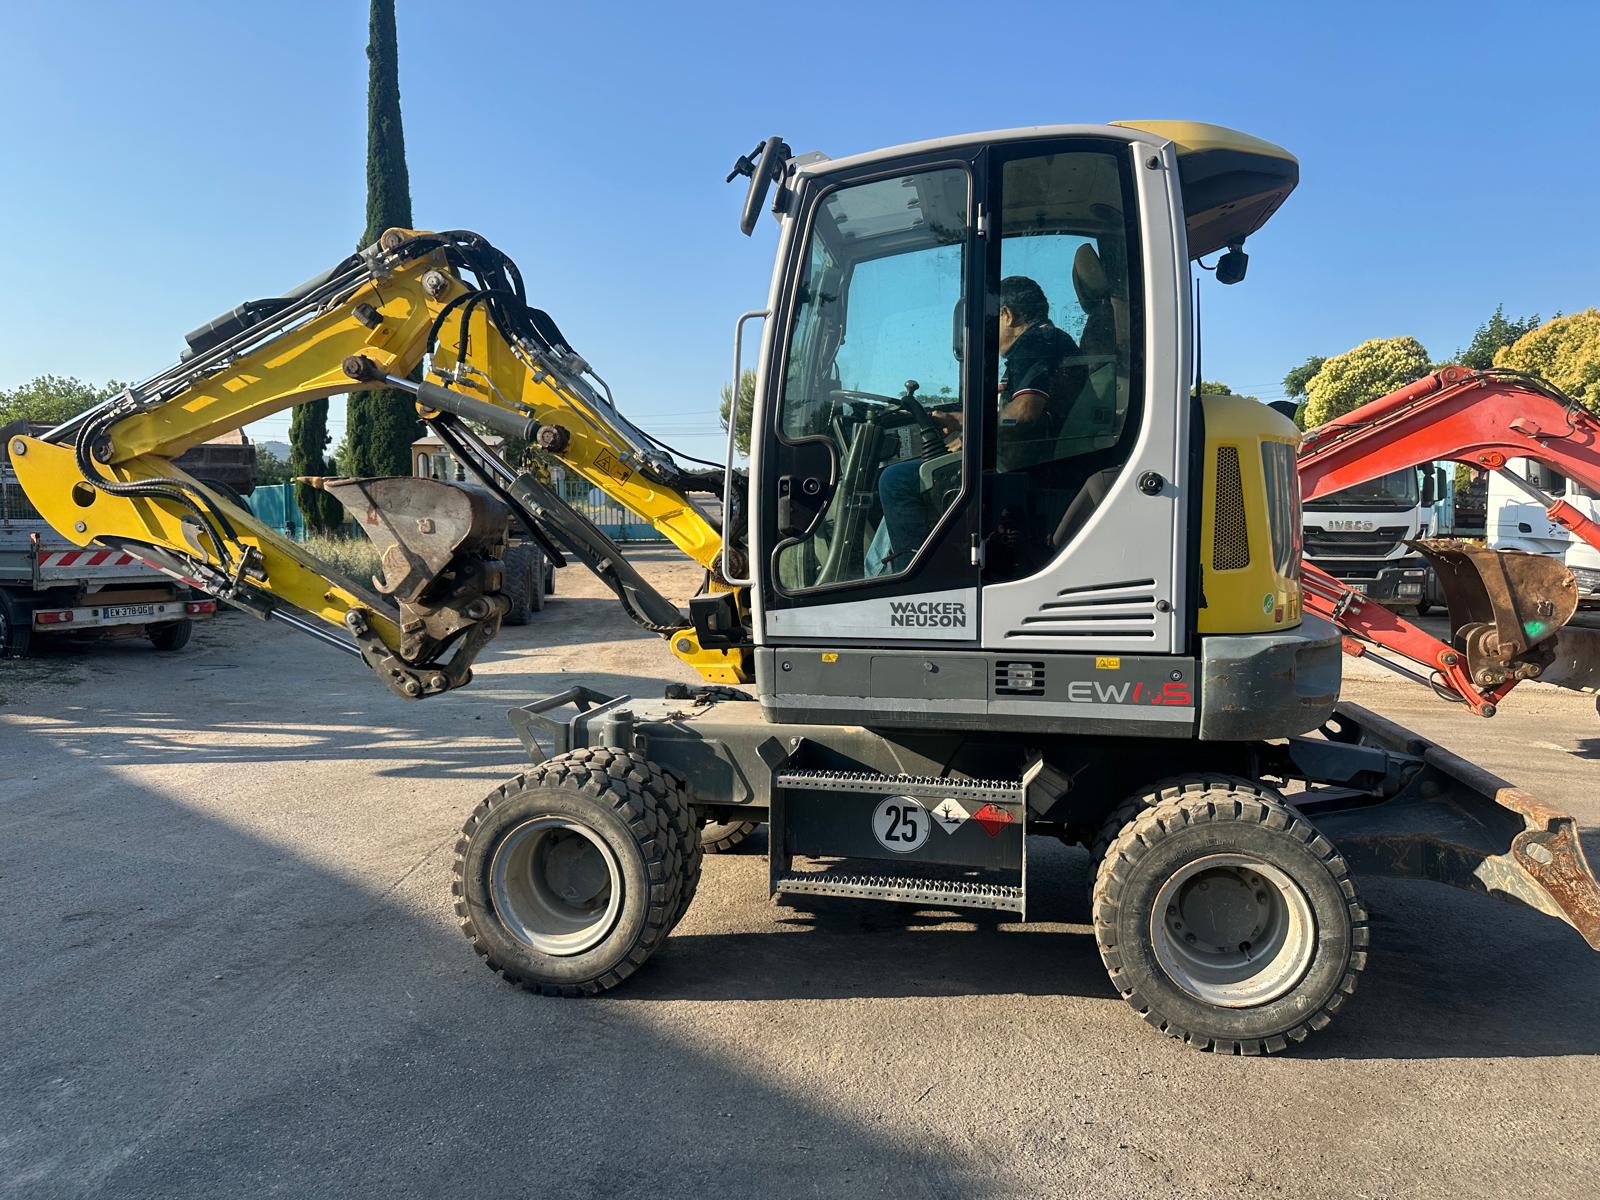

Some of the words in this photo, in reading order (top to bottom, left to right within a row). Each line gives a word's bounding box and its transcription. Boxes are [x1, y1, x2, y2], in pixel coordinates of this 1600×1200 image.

[1328, 520, 1373, 531] IVECO
[889, 602, 966, 615] WACKER
[891, 614, 966, 627] NEUSON
[885, 805, 918, 842] 25
